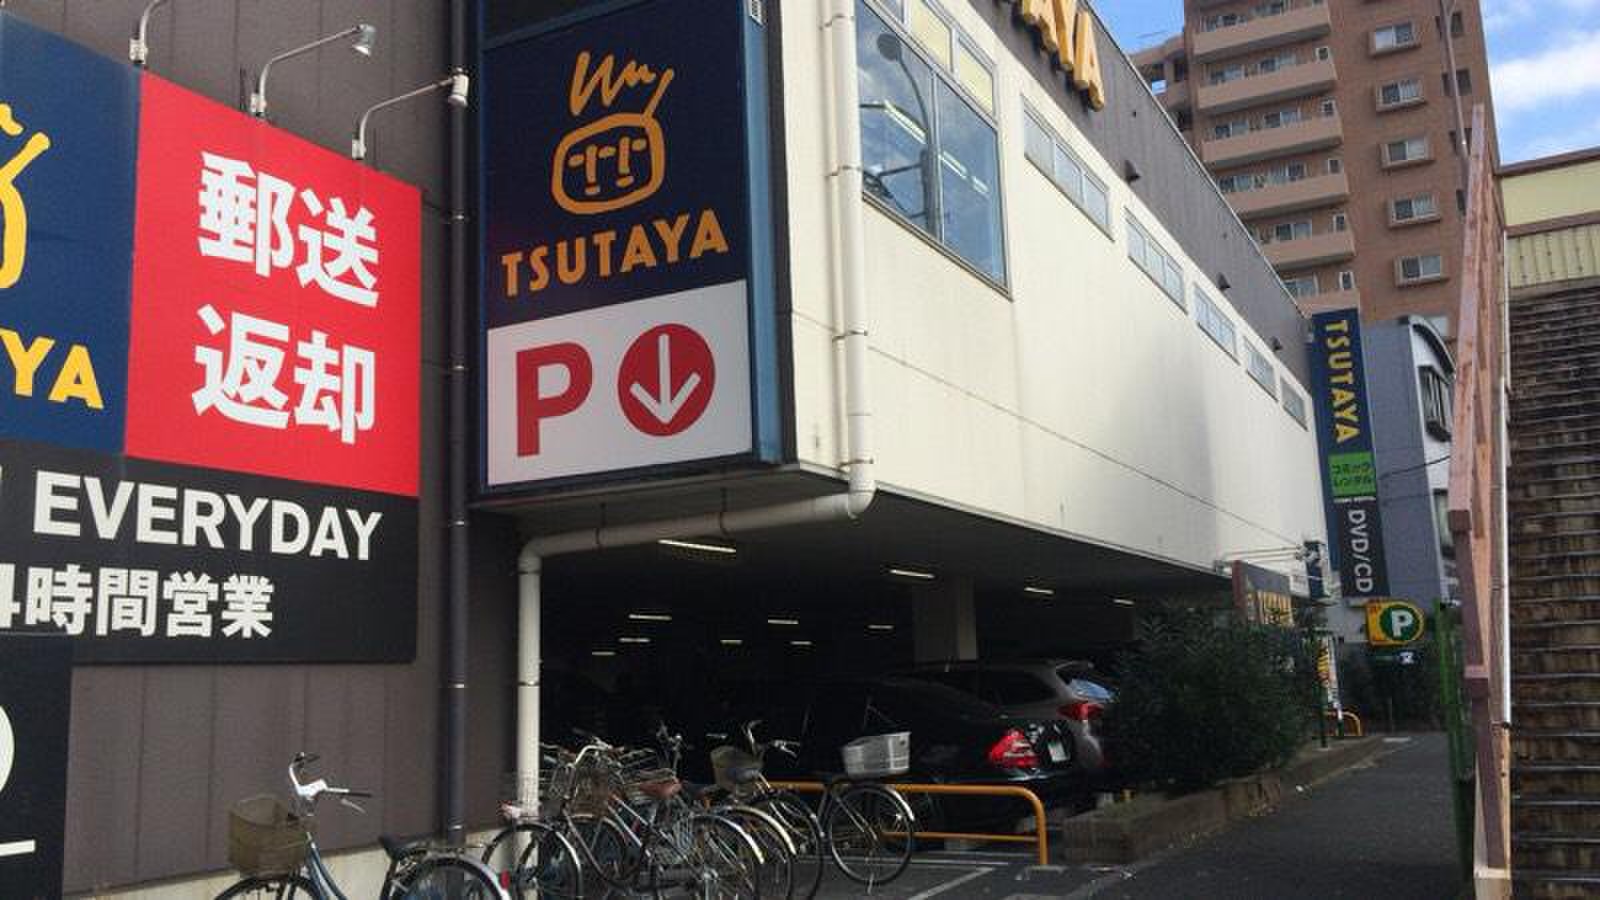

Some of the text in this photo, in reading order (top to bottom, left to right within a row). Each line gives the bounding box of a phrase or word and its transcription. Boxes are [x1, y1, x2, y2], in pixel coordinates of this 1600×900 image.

[197, 151, 380, 308] 郵送
[501, 208, 730, 297] TSUTAYA
[191, 303, 376, 445] 返却
[515, 342, 593, 458] P
[1325, 319, 1361, 444] TSUTAYA
[34, 470, 382, 561] EVERYDAY
[1347, 509, 1373, 593] DVD/CD
[1391, 610, 1414, 638] P
